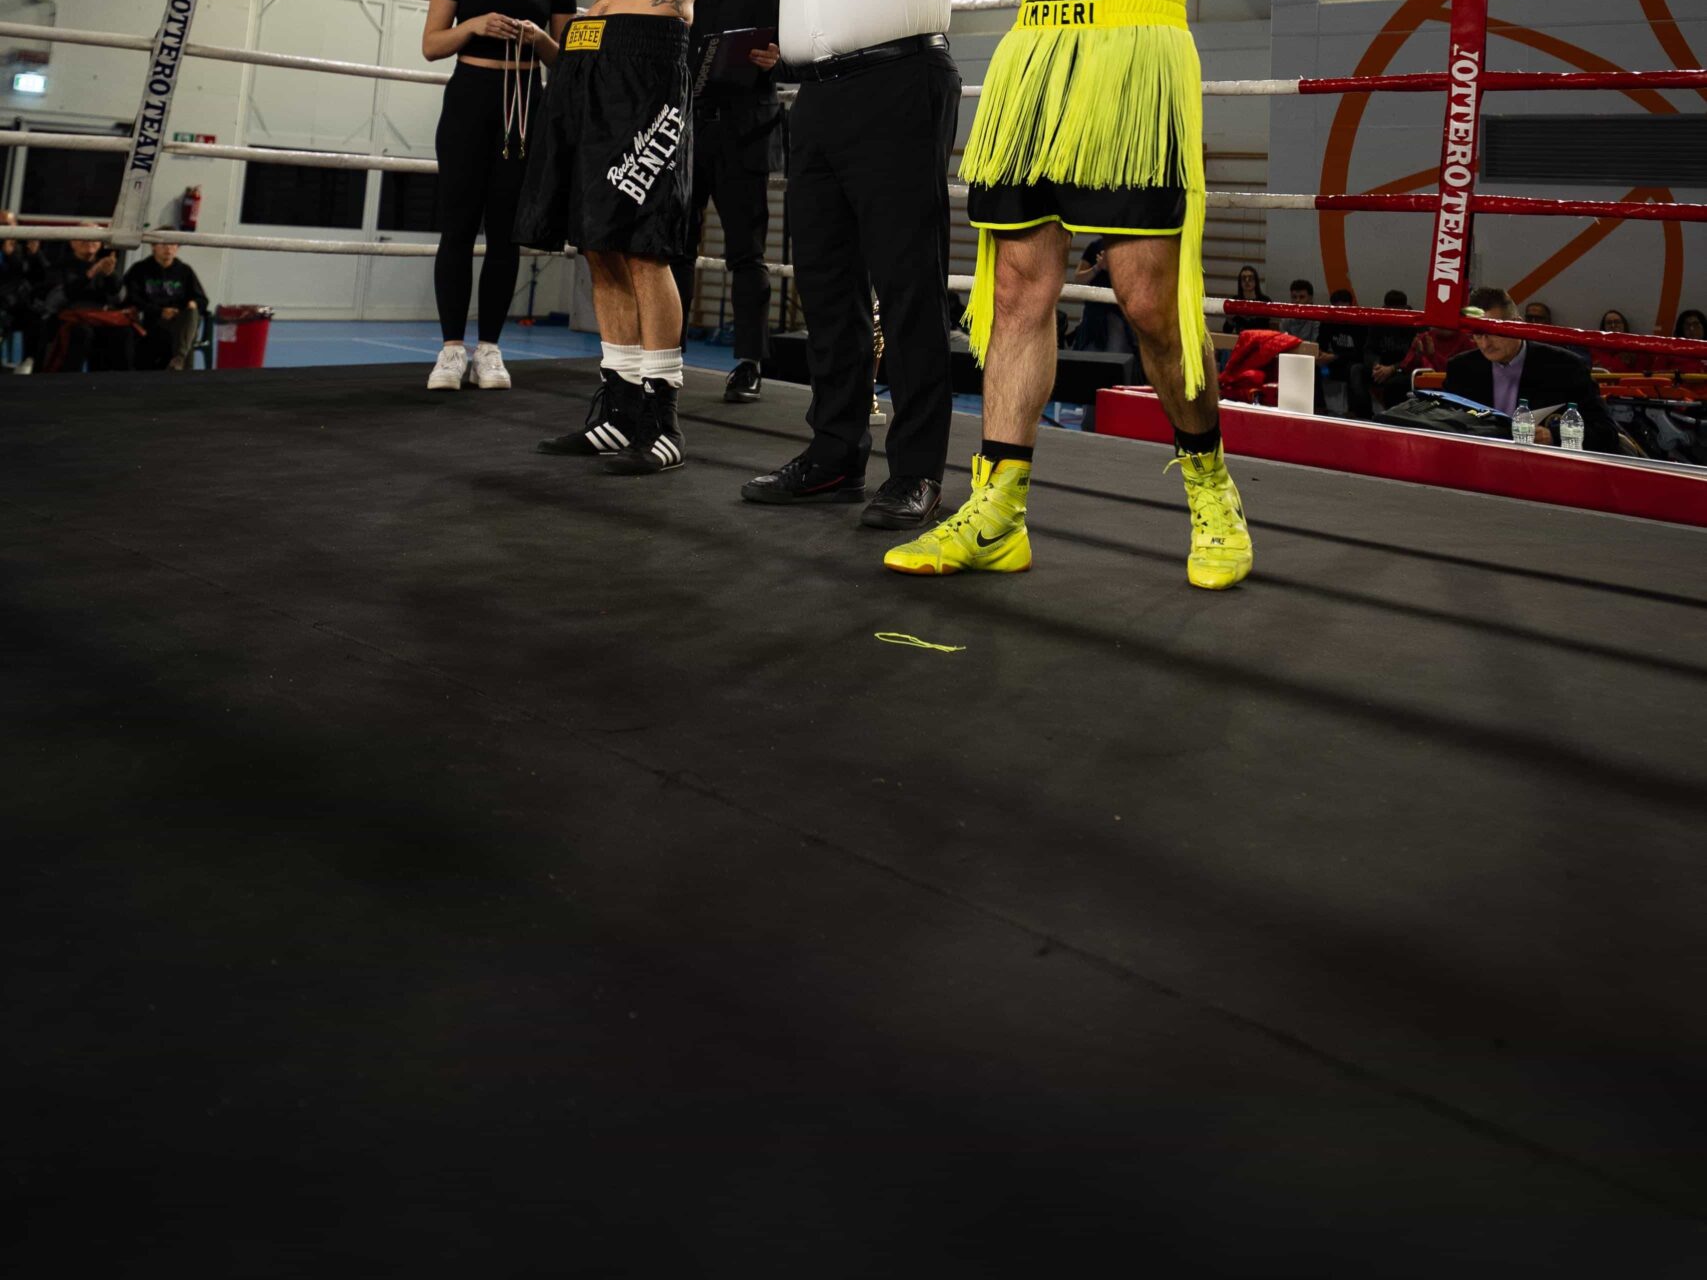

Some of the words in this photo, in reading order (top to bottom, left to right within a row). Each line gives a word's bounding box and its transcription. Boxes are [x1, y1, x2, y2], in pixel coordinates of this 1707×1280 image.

[568, 30, 600, 44] BENLEE
[131, 100, 166, 173] TEAM
[606, 152, 640, 186] Rocky
[617, 106, 685, 206] BENLEE
[1433, 191, 1469, 284] TEAM
